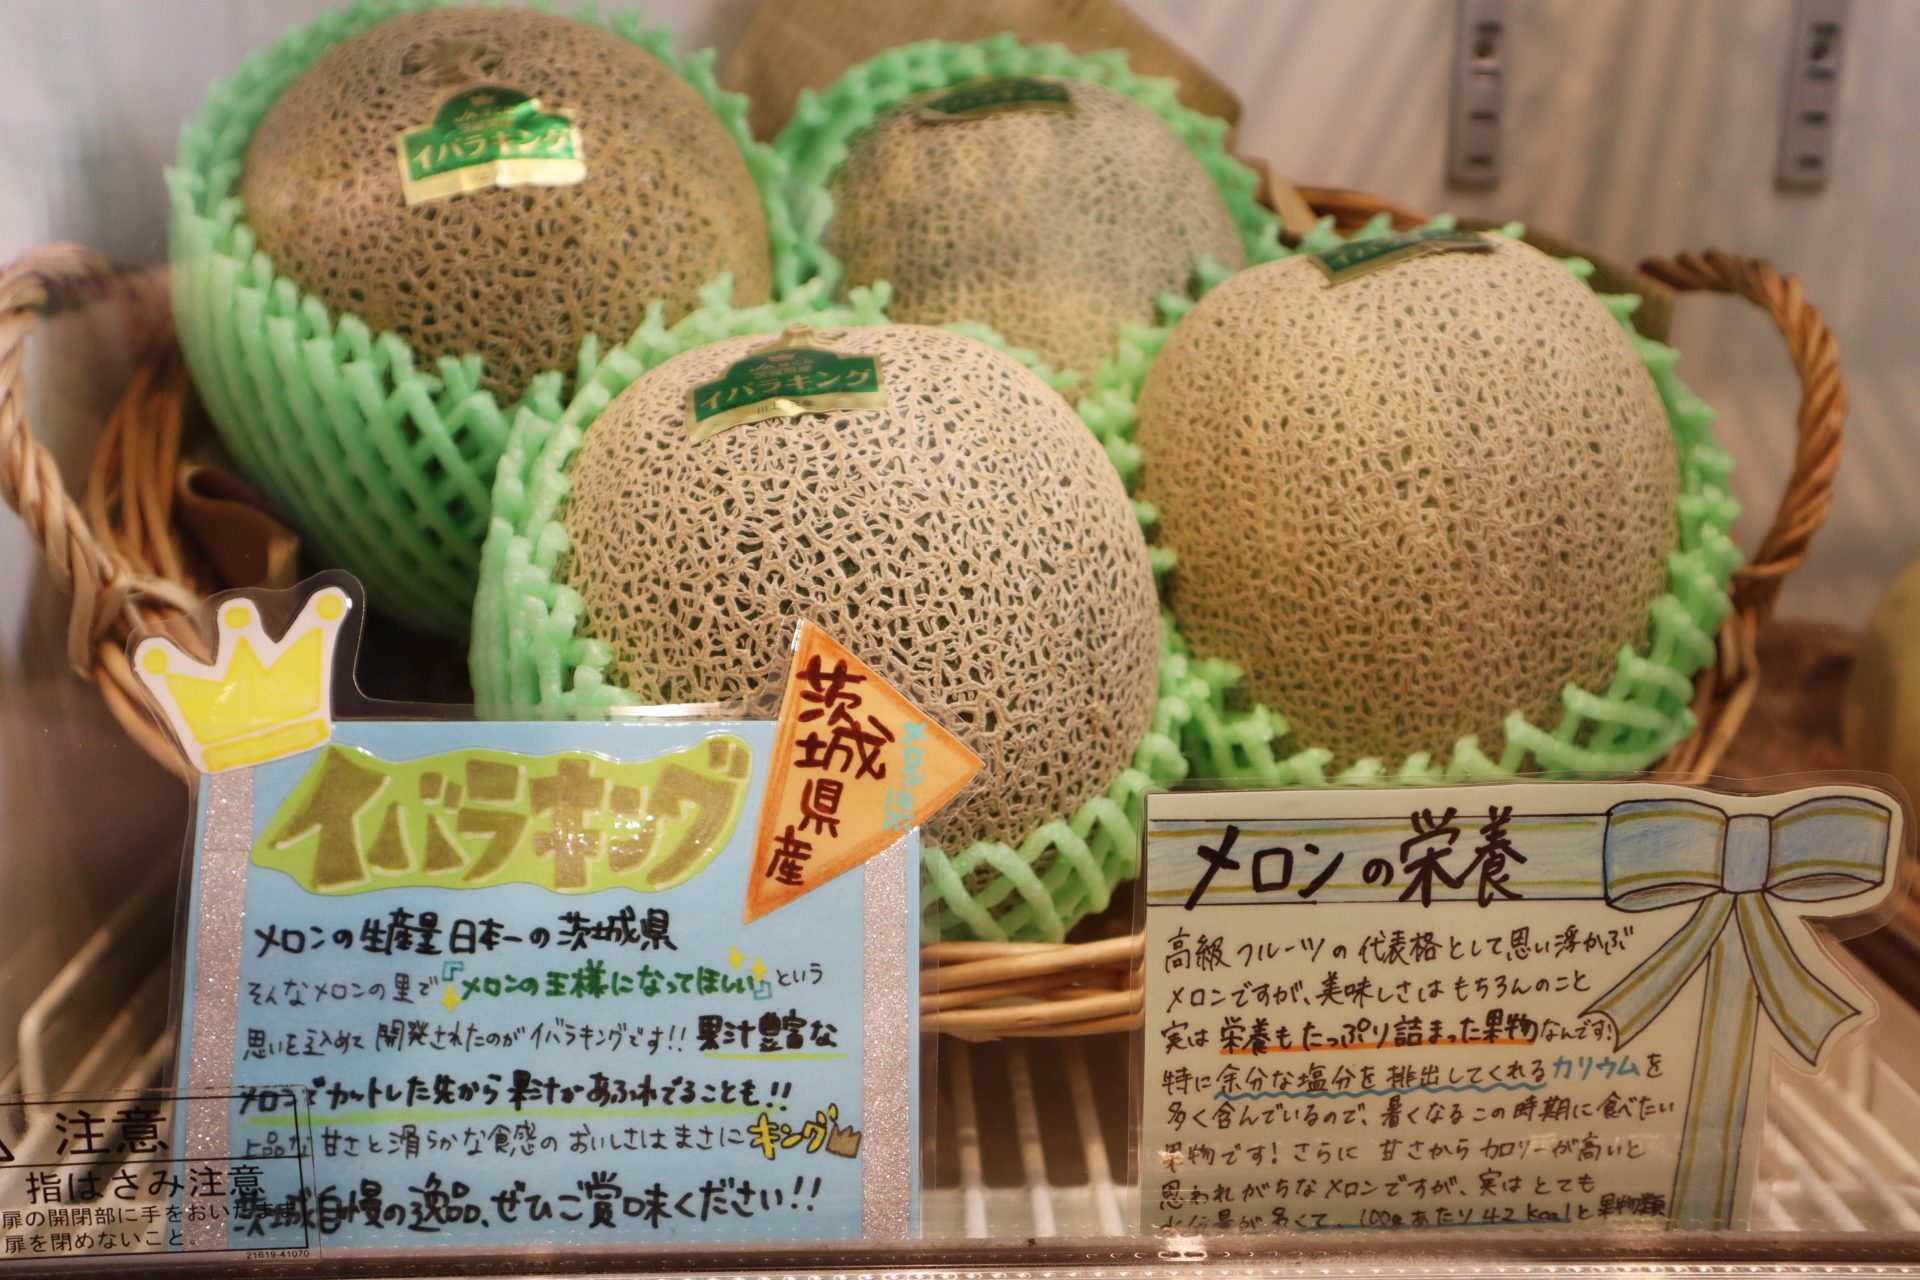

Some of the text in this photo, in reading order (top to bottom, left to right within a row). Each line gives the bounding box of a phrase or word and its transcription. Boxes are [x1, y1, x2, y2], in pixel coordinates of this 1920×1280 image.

[412, 128, 570, 171] イバラキング
[701, 368, 872, 410] イバラキング
[765, 654, 895, 886] 茨城県産
[272, 738, 746, 889] イバラキング
[1184, 805, 1528, 911] メロンの栄養
[55, 1105, 170, 1156] 注意
[25, 1164, 266, 1205] 指はさみ注意
[2, 1199, 298, 1230] 扉の開閉部に手をおいたまま
[5, 1229, 197, 1255] 扉を閉めないこと。
